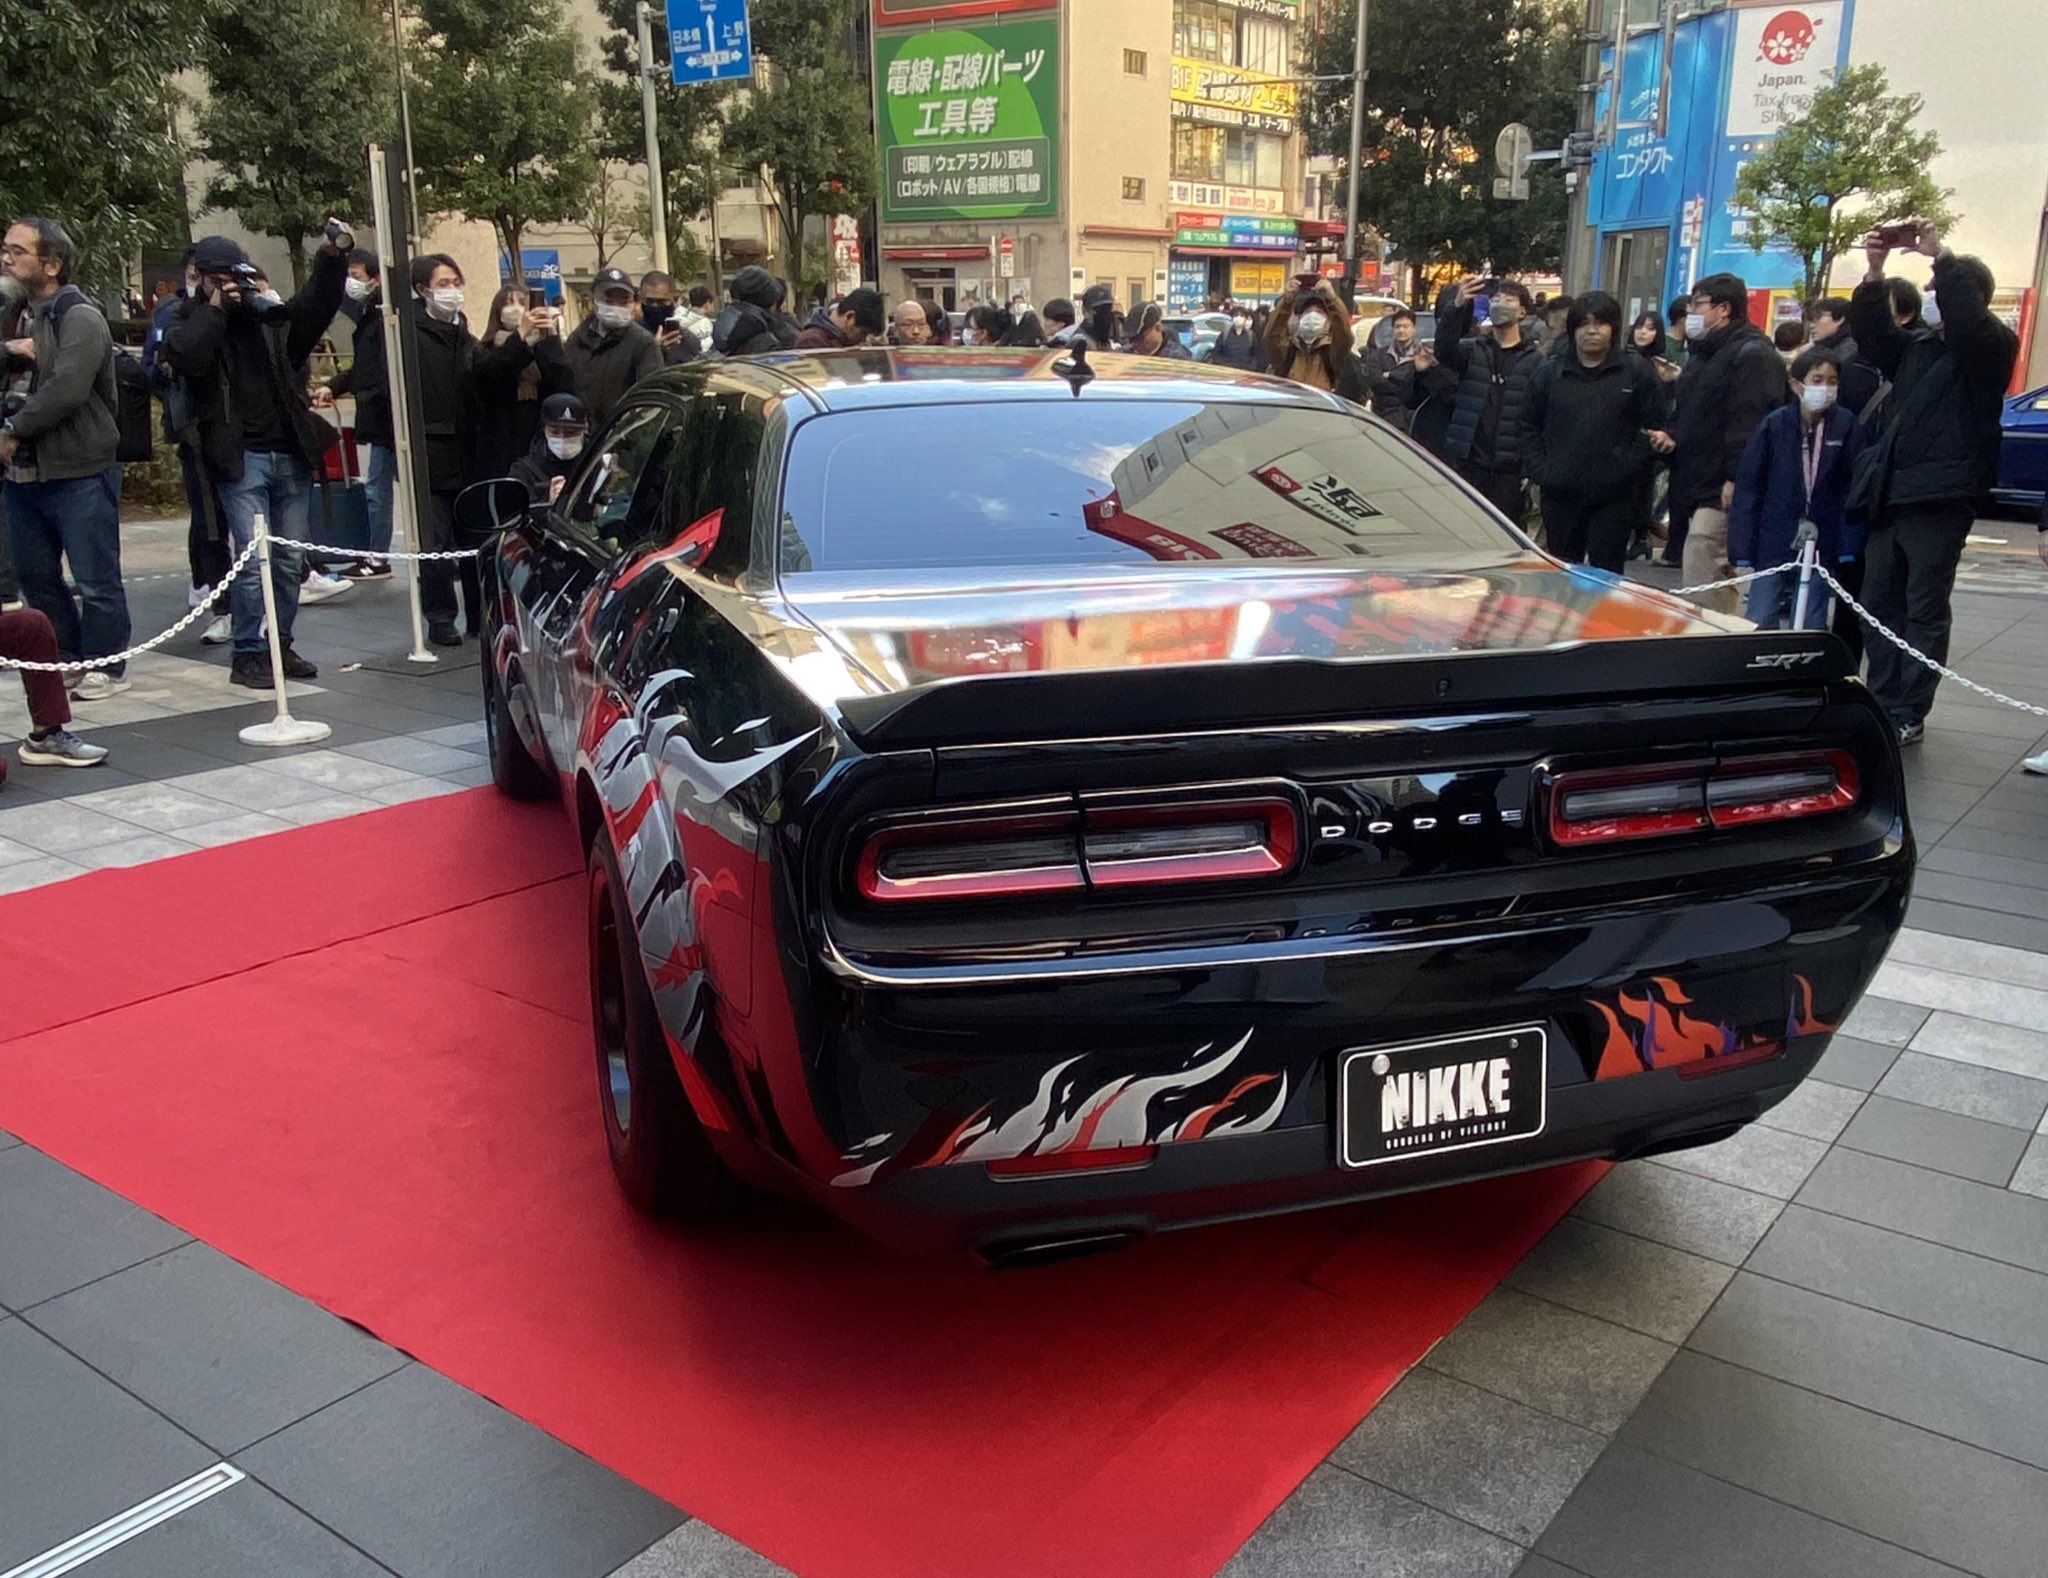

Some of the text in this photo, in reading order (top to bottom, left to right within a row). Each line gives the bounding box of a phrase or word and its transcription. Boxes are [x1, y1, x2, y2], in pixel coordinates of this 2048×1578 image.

[887, 49, 1045, 96] 電線・配線パーツ
[913, 96, 998, 136] 工具等
[1616, 146, 1673, 179] コンタクト
[1746, 650, 1825, 670] SRT
[1320, 809, 1522, 838] DODGE
